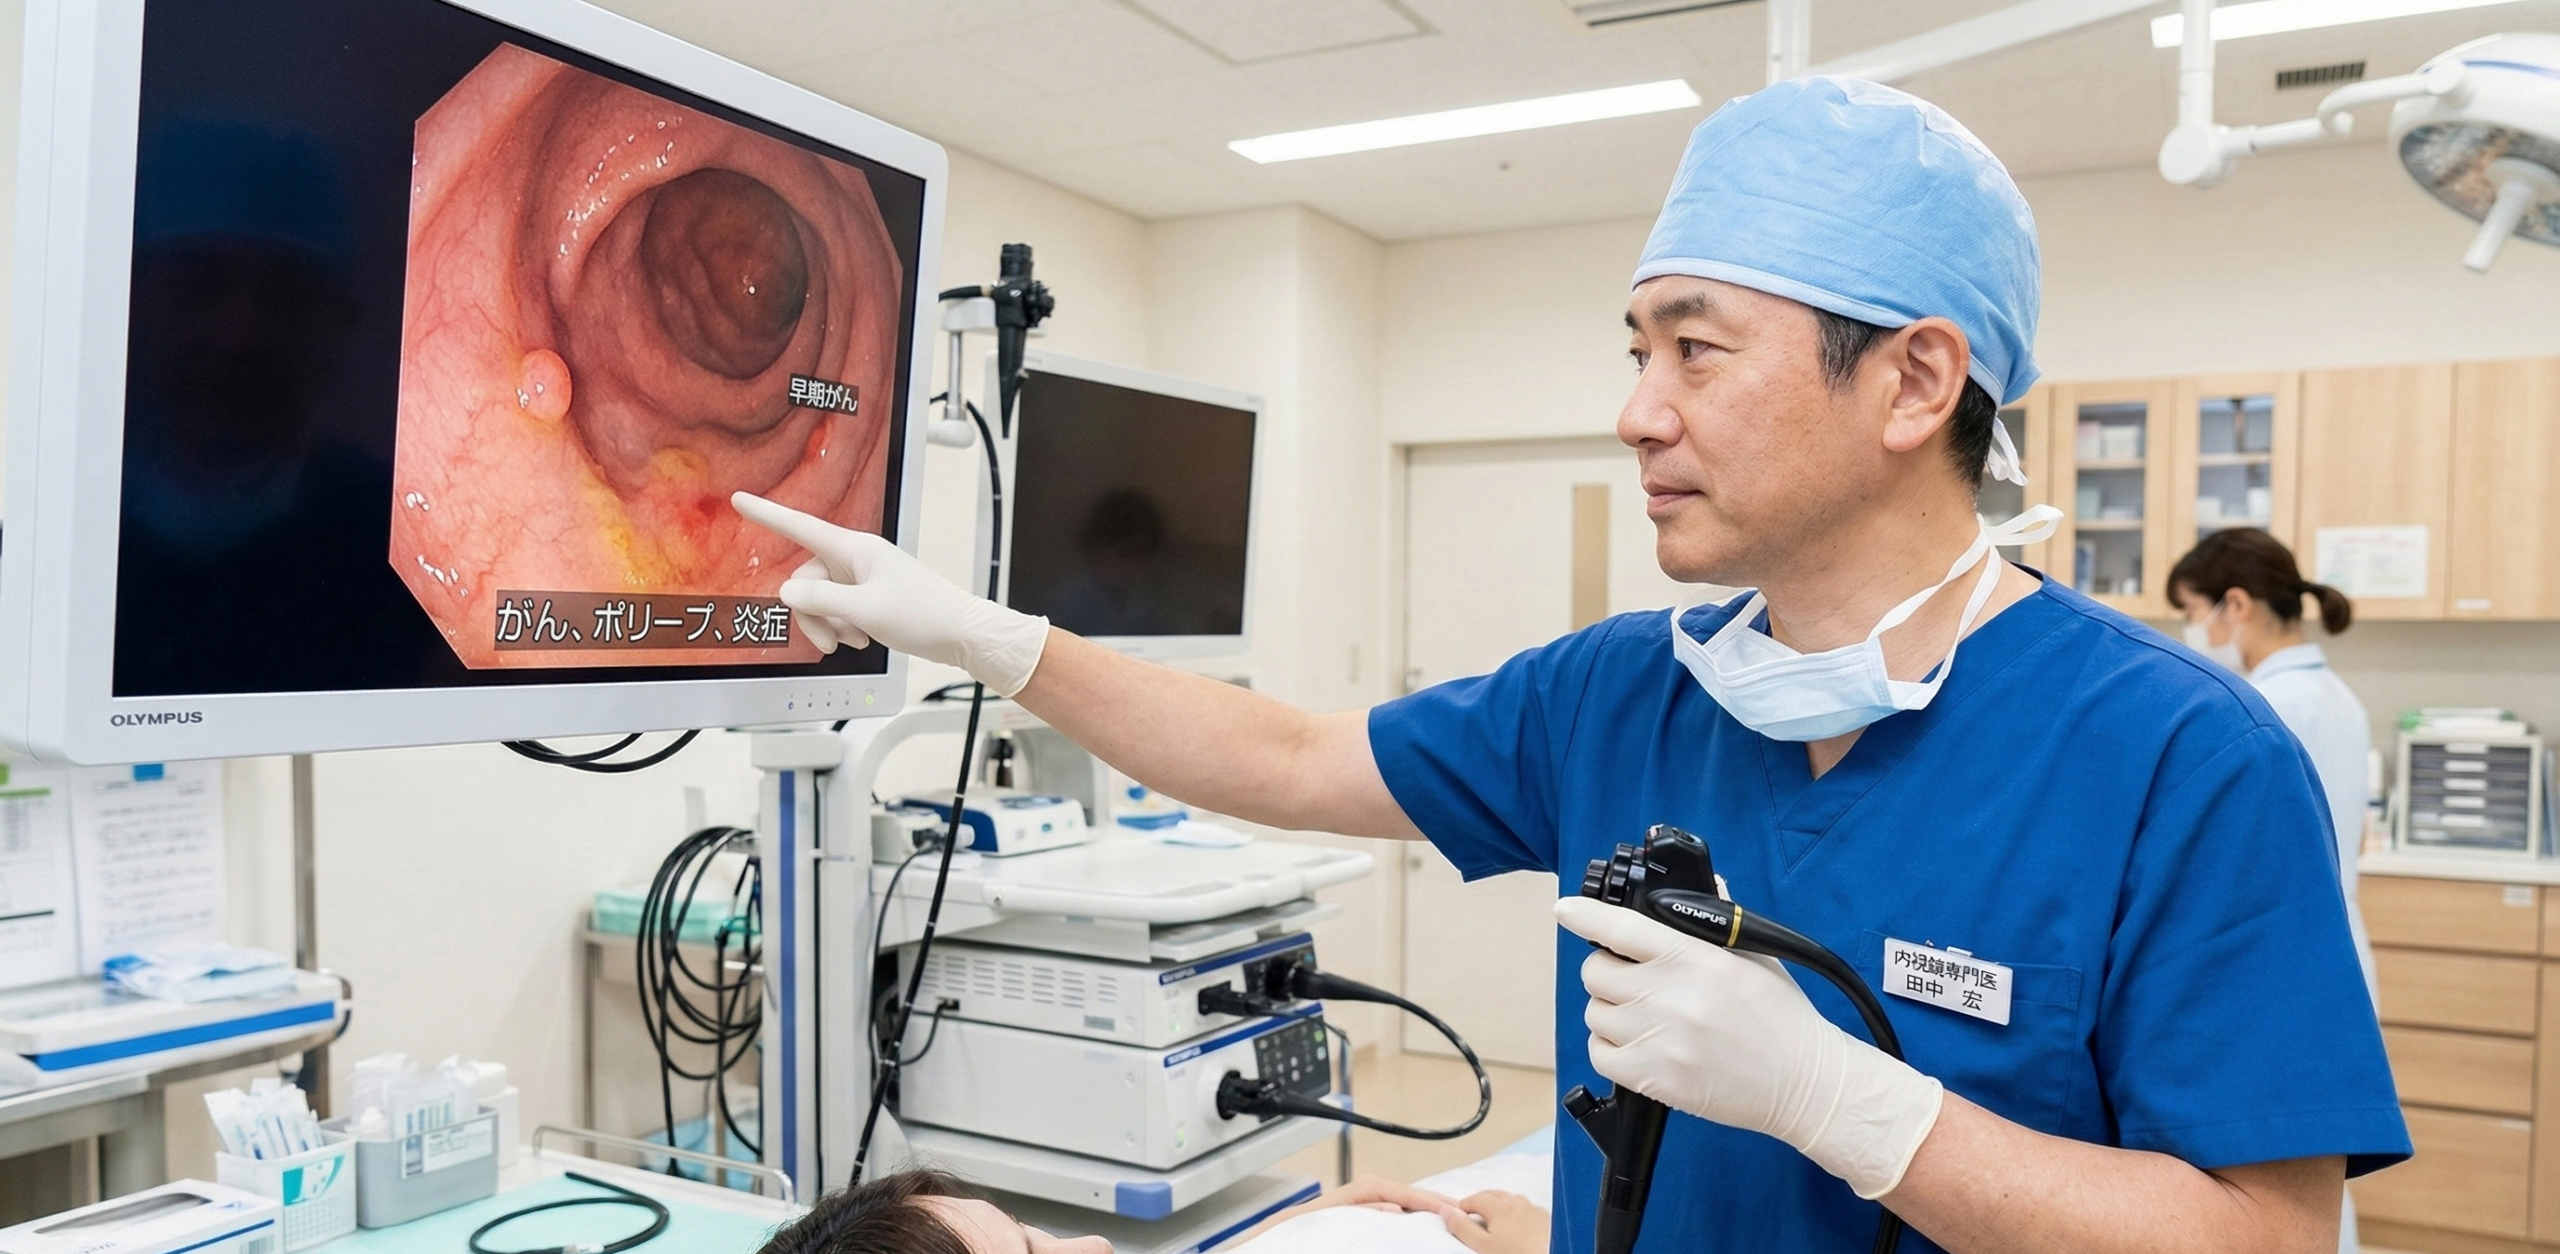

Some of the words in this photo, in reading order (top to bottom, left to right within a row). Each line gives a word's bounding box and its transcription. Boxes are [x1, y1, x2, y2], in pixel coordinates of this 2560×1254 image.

[789, 377, 858, 412] 早期がん
[496, 598, 789, 643] がん、ポリープ、炎症
[110, 711, 203, 727] OLYMPUS
[1906, 974, 1944, 998] 田中
[1961, 989, 1983, 1011] 宏
